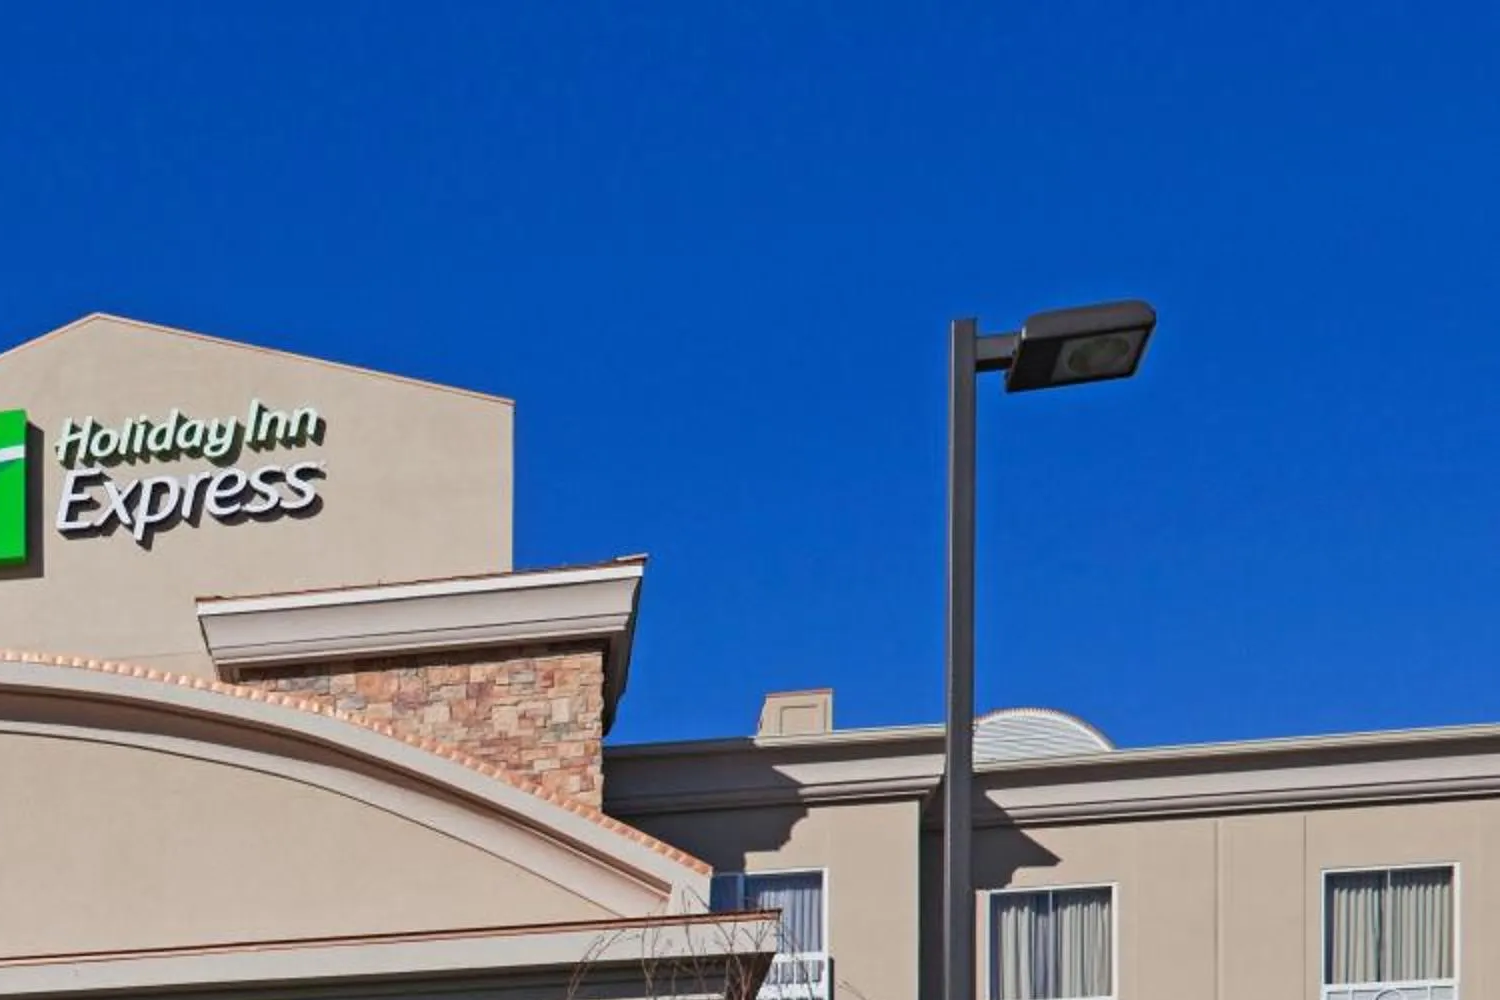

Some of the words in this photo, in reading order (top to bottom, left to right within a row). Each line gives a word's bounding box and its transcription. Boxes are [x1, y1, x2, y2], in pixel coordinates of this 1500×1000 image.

[55, 407, 238, 460] Holiday
[244, 397, 318, 443] Inn
[55, 460, 319, 542] Express
